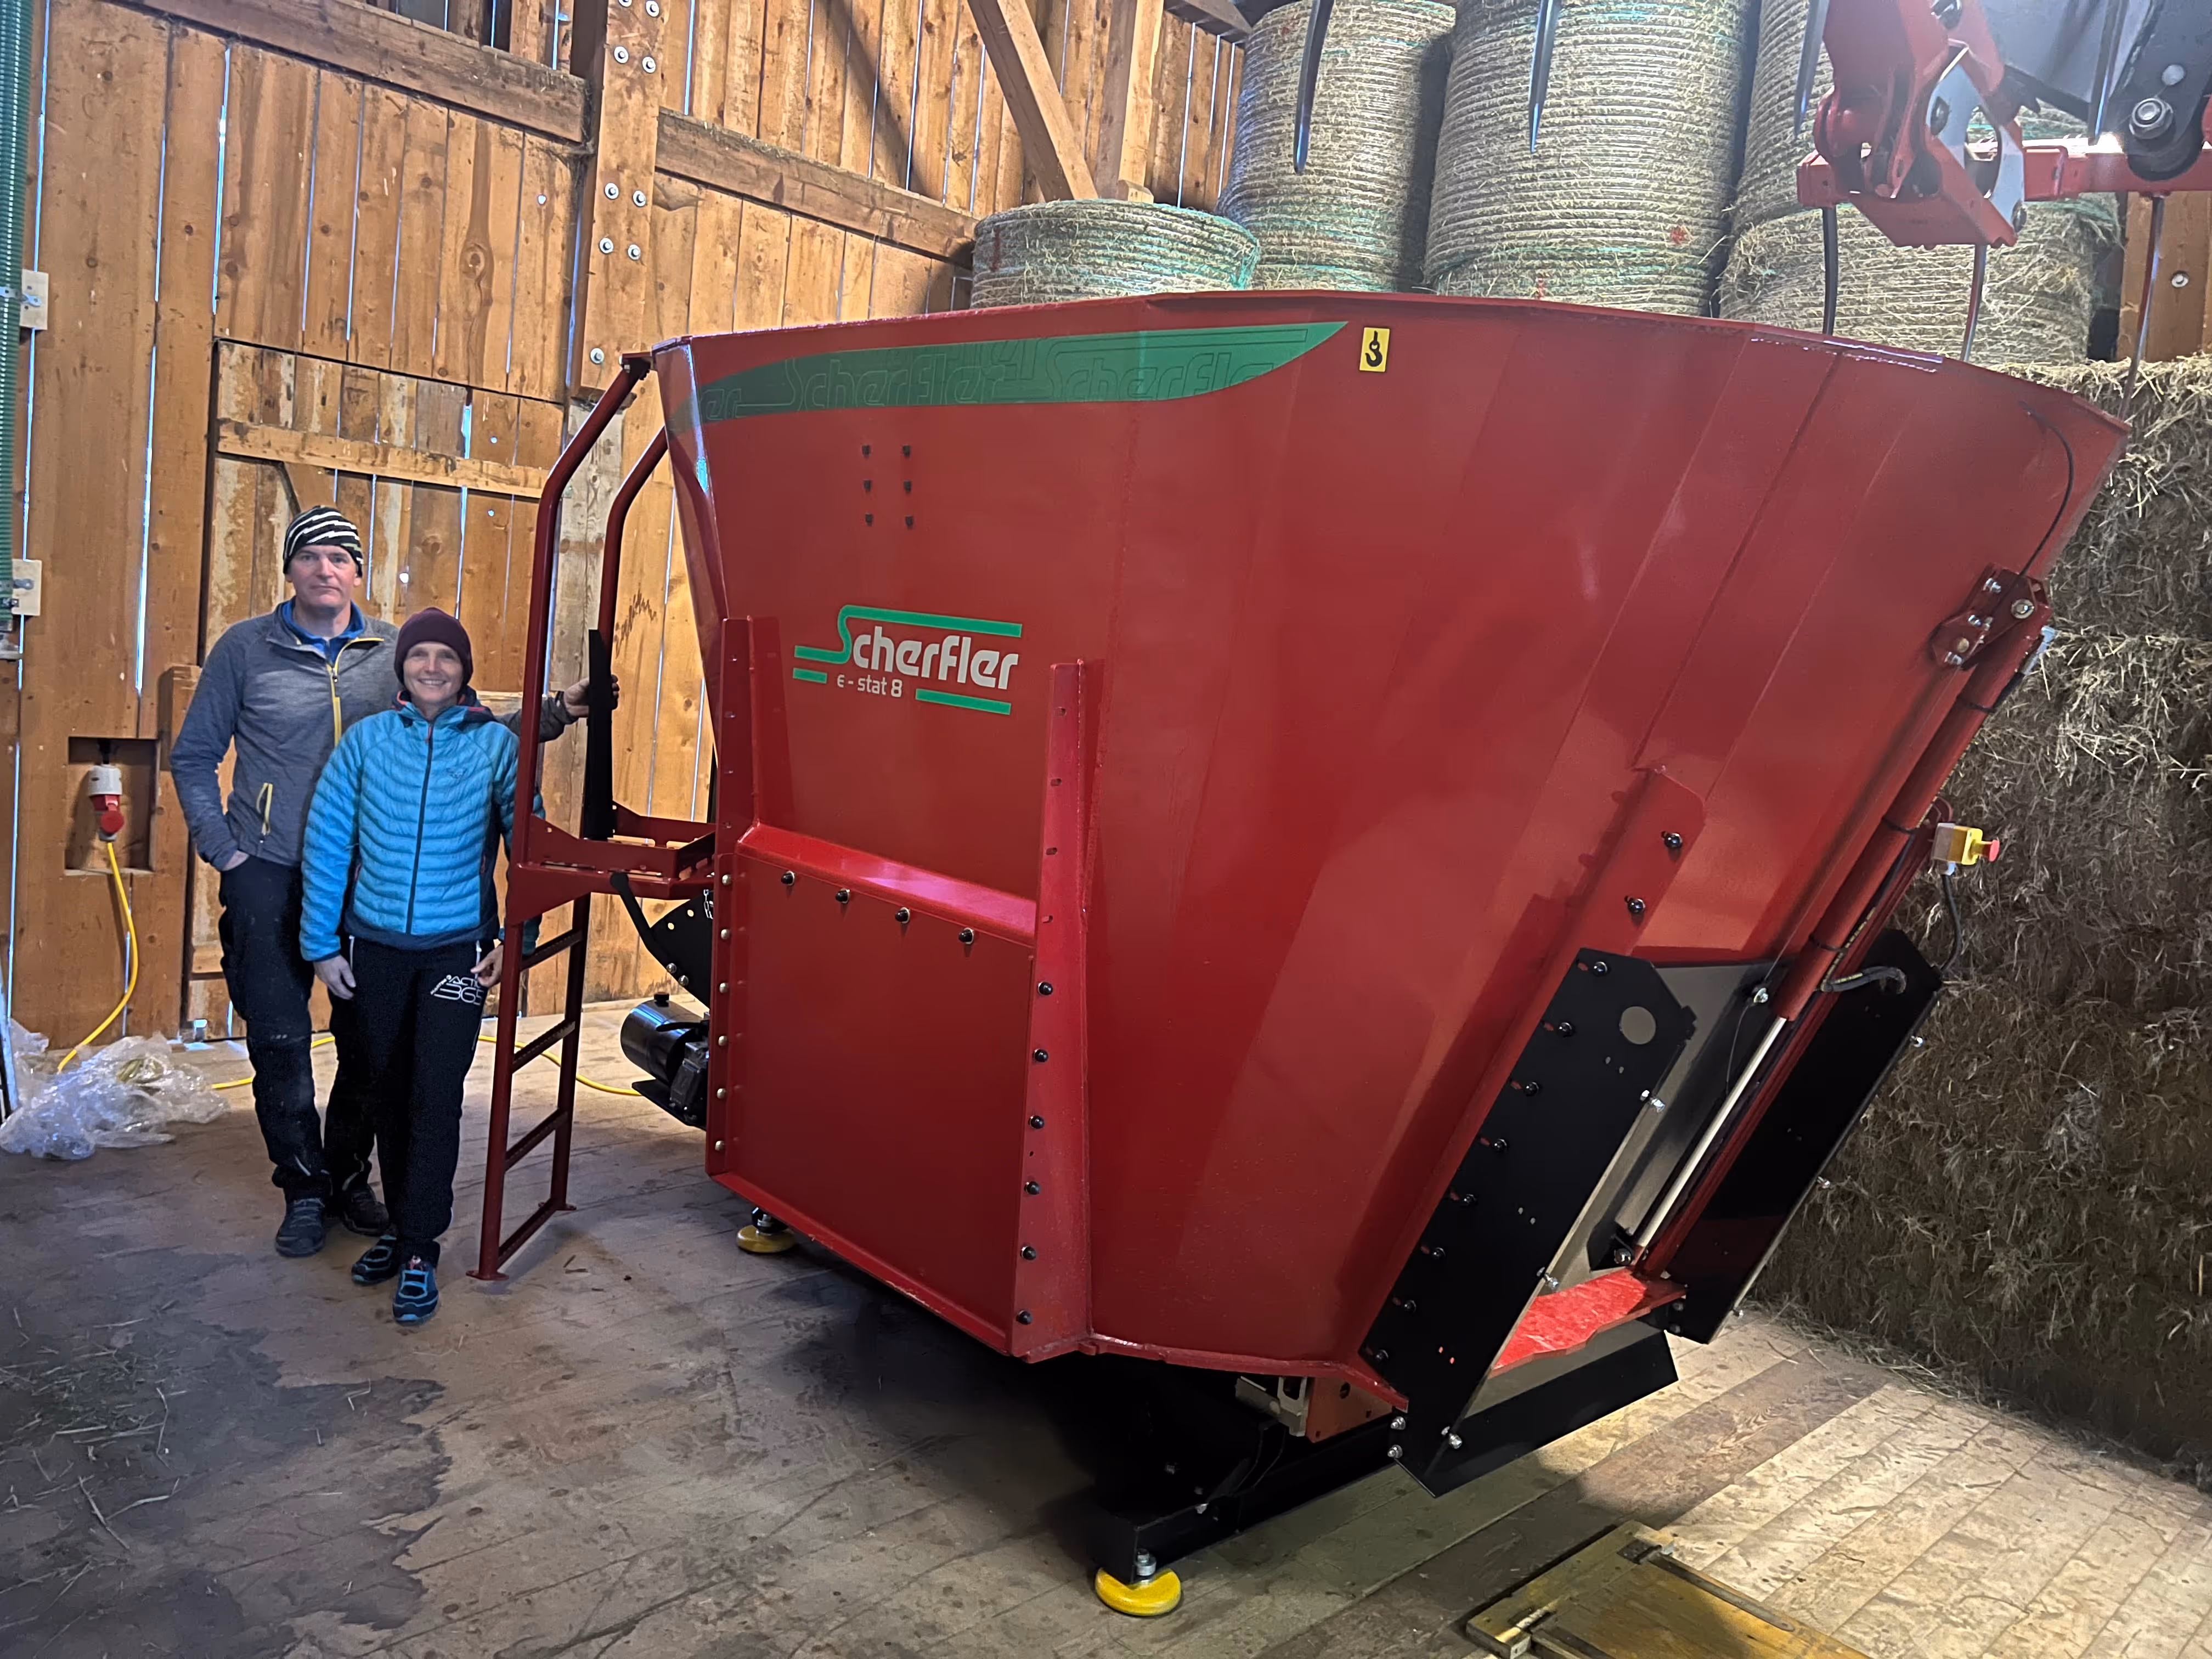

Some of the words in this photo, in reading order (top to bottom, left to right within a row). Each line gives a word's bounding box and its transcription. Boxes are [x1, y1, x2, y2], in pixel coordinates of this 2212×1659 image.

[794, 605, 1023, 690] Scherfler
[857, 675, 887, 696] stat
[890, 679, 904, 698] 8
[433, 983, 484, 1006] 365
